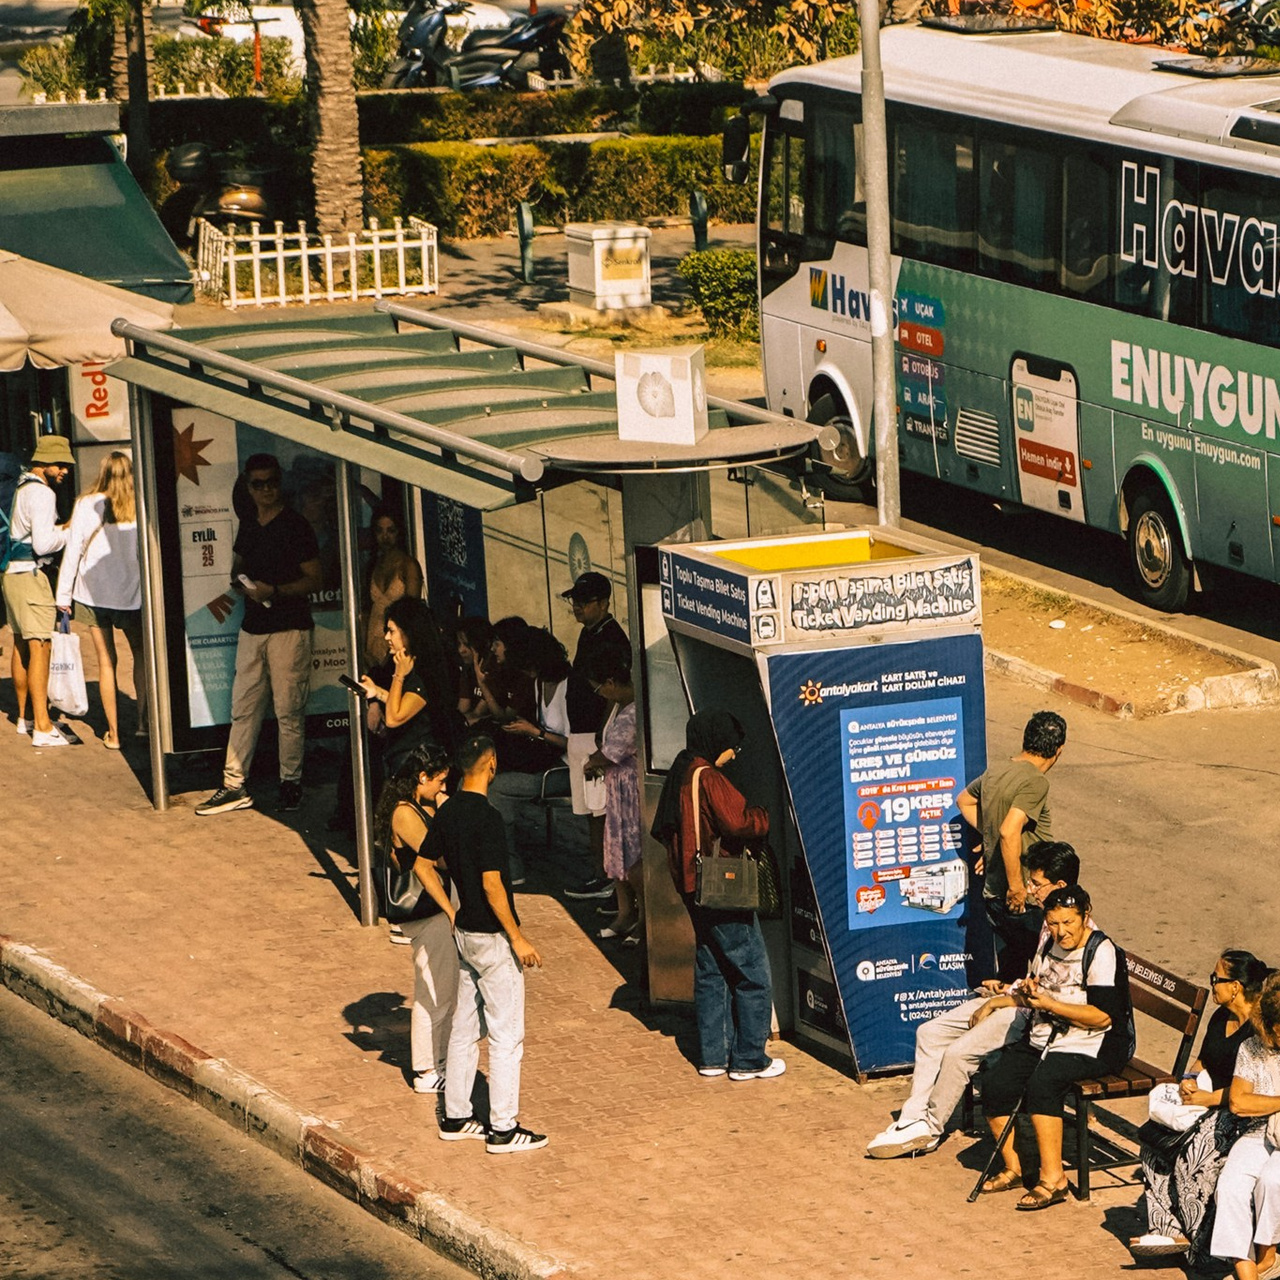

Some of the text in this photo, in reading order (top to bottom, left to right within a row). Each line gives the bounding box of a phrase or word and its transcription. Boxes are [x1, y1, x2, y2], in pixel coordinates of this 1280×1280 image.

[915, 302, 934, 318] UÇAK
[916, 332, 933, 346] OTEL
[912, 361, 938, 379] OTOBÜS
[1018, 398, 1033, 421] EN
[1142, 422, 1260, 470] En uygunu Enuygun.com
[1021, 448, 1062, 470] Hemen indir
[192, 528, 217, 542] EYLÜL
[202, 545, 214, 555] 20
[202, 556, 214, 567] 25
[676, 565, 746, 605] Toplu Taşıma Bilet Satış
[677, 593, 747, 630] Ticket Vending Machine
[793, 595, 975, 628] Ticket Vending Machine
[323, 659, 346, 668] Moo
[882, 673, 903, 682] KART
[904, 671, 926, 681] SATIŞ
[882, 675, 965, 693] KART DOLUM CİHAZI
[820, 681, 878, 696] antalyakart
[326, 719, 349, 728] COR
[860, 722, 885, 731] ANTALYA
[850, 747, 957, 769] KREŞ VE GÜNDÜZ
[850, 764, 910, 782] BAKIMEVİ
[910, 793, 953, 809] KREŞ
[880, 797, 910, 823] 19
[920, 810, 942, 819] AÇTIK
[940, 954, 973, 962] ANTALYA
[939, 963, 964, 971] ULAŞIM
[1135, 964, 1163, 985] BELEDİYESİ
[909, 1010, 932, 1020] (0242)
